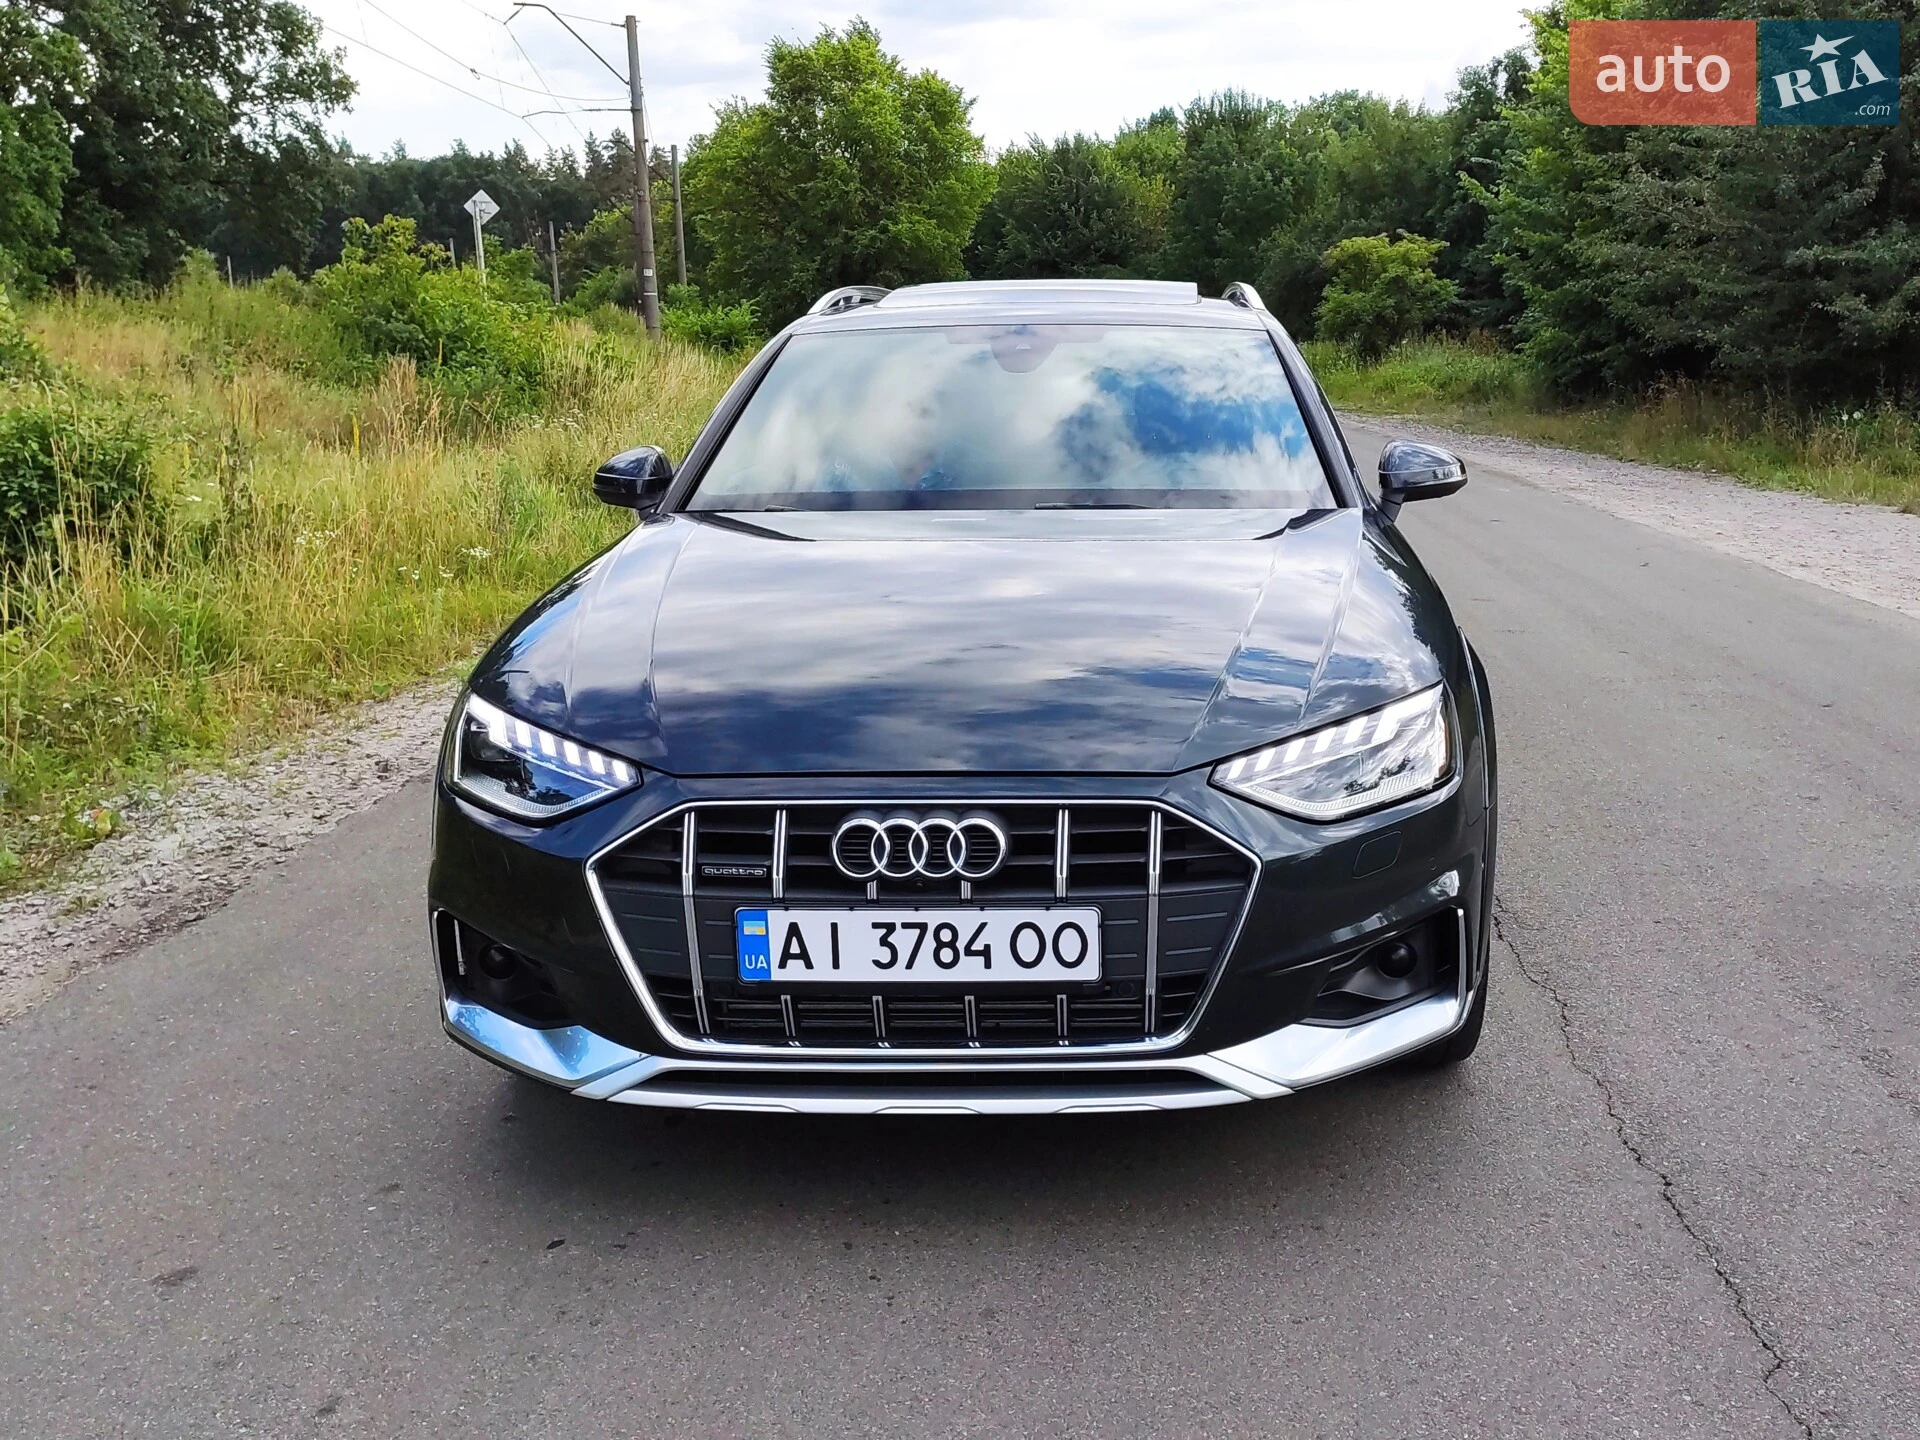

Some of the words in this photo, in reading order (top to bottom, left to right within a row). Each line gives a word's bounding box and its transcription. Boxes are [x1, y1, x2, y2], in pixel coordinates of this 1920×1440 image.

[704, 868, 764, 876] quattro
[777, 921, 841, 970] AI
[871, 921, 992, 970] 3784
[744, 954, 768, 970] UA
